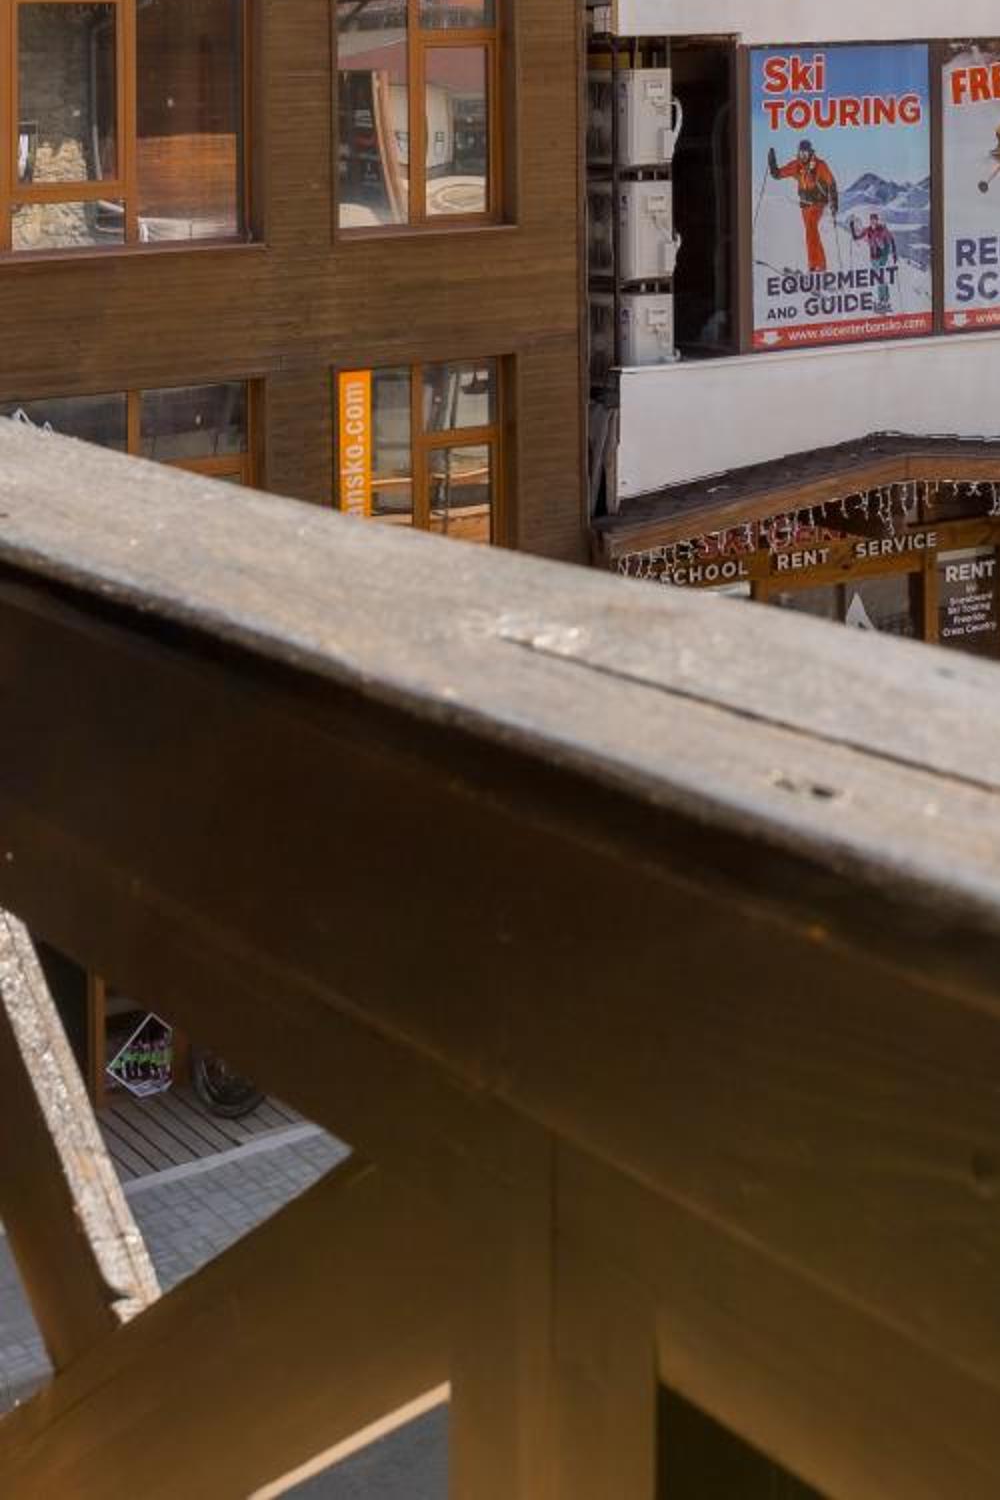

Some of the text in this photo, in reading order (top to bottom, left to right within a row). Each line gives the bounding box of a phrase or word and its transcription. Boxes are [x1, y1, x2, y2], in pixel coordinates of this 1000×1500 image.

[763, 55, 826, 93] Ski
[763, 95, 922, 131] TOURING
[767, 266, 899, 296] EQUIPMENT
[767, 305, 797, 319] AND
[777, 550, 830, 571] RENT
[856, 532, 937, 559] SERVICE
[945, 560, 996, 582] RENT
